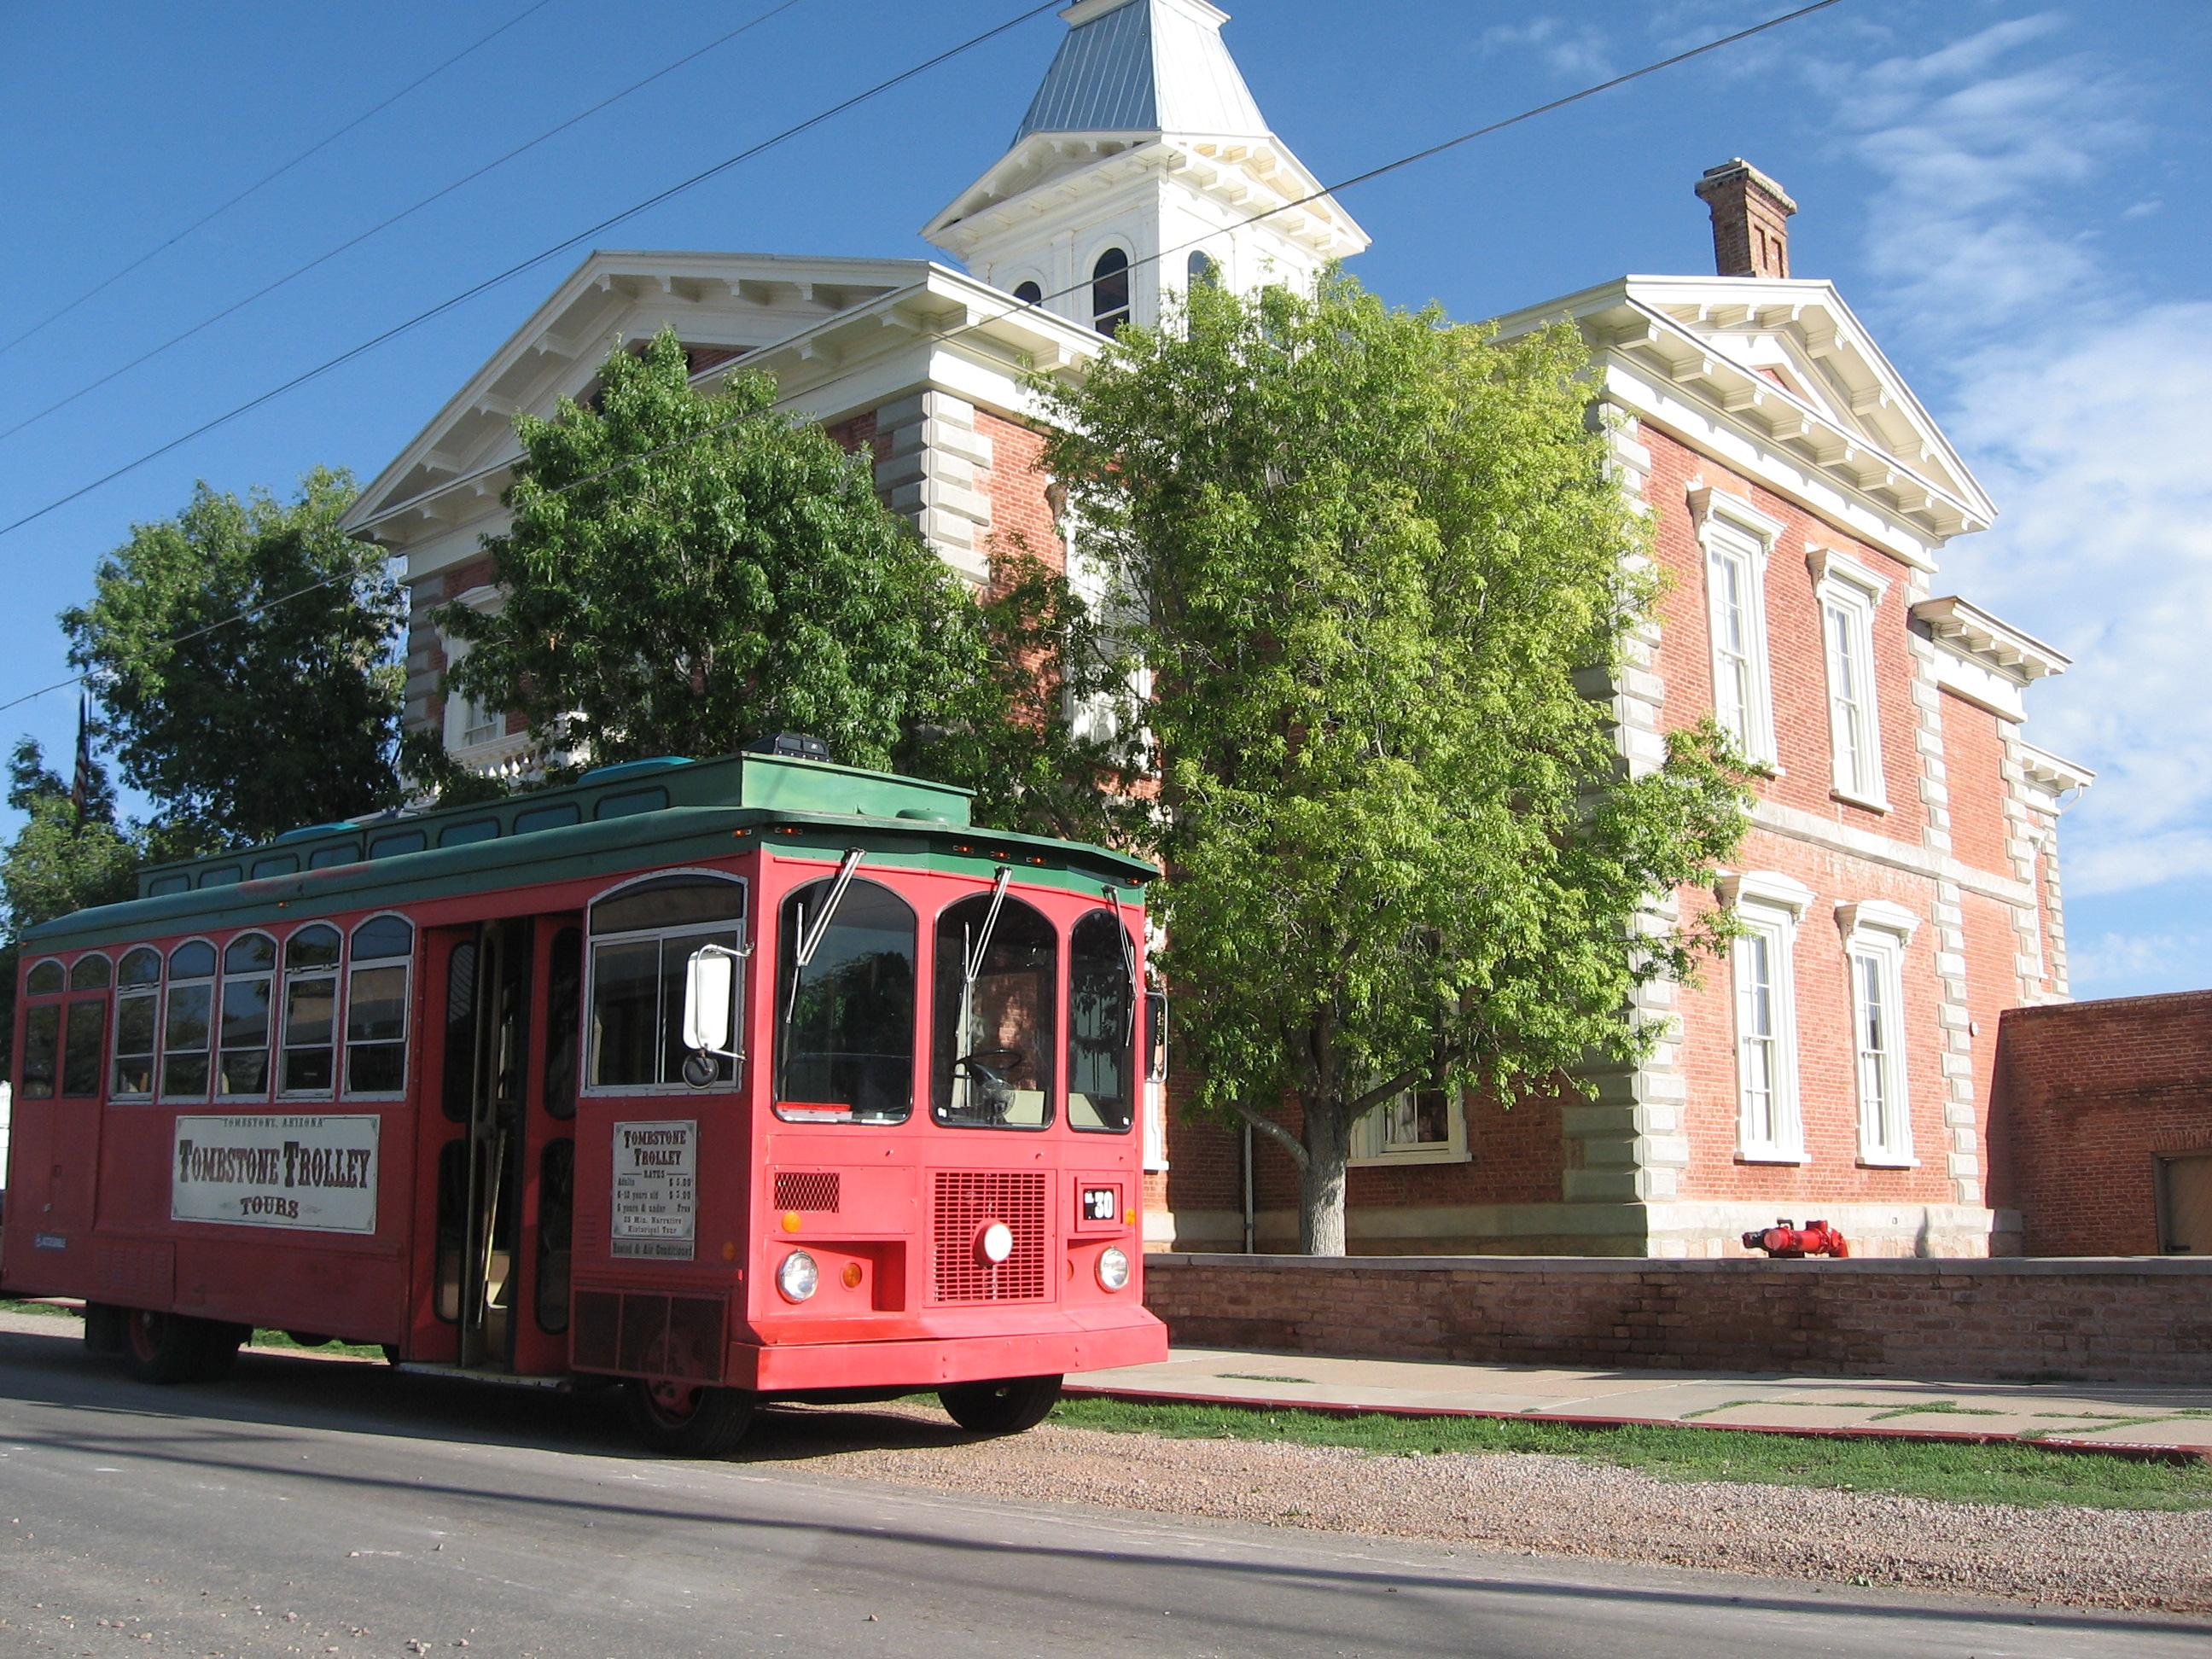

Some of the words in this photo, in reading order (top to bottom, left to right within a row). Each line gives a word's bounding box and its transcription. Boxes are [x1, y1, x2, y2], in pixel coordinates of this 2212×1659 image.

[624, 1130, 686, 1149] TOMBSTONE
[179, 1139, 281, 1185] TOMBSTONE
[283, 1141, 370, 1189] TROLLEY
[634, 1148, 682, 1167] TROLLEY
[643, 1170, 666, 1179] RATES
[240, 1196, 299, 1220] TOURS
[1095, 1191, 1113, 1218] 30
